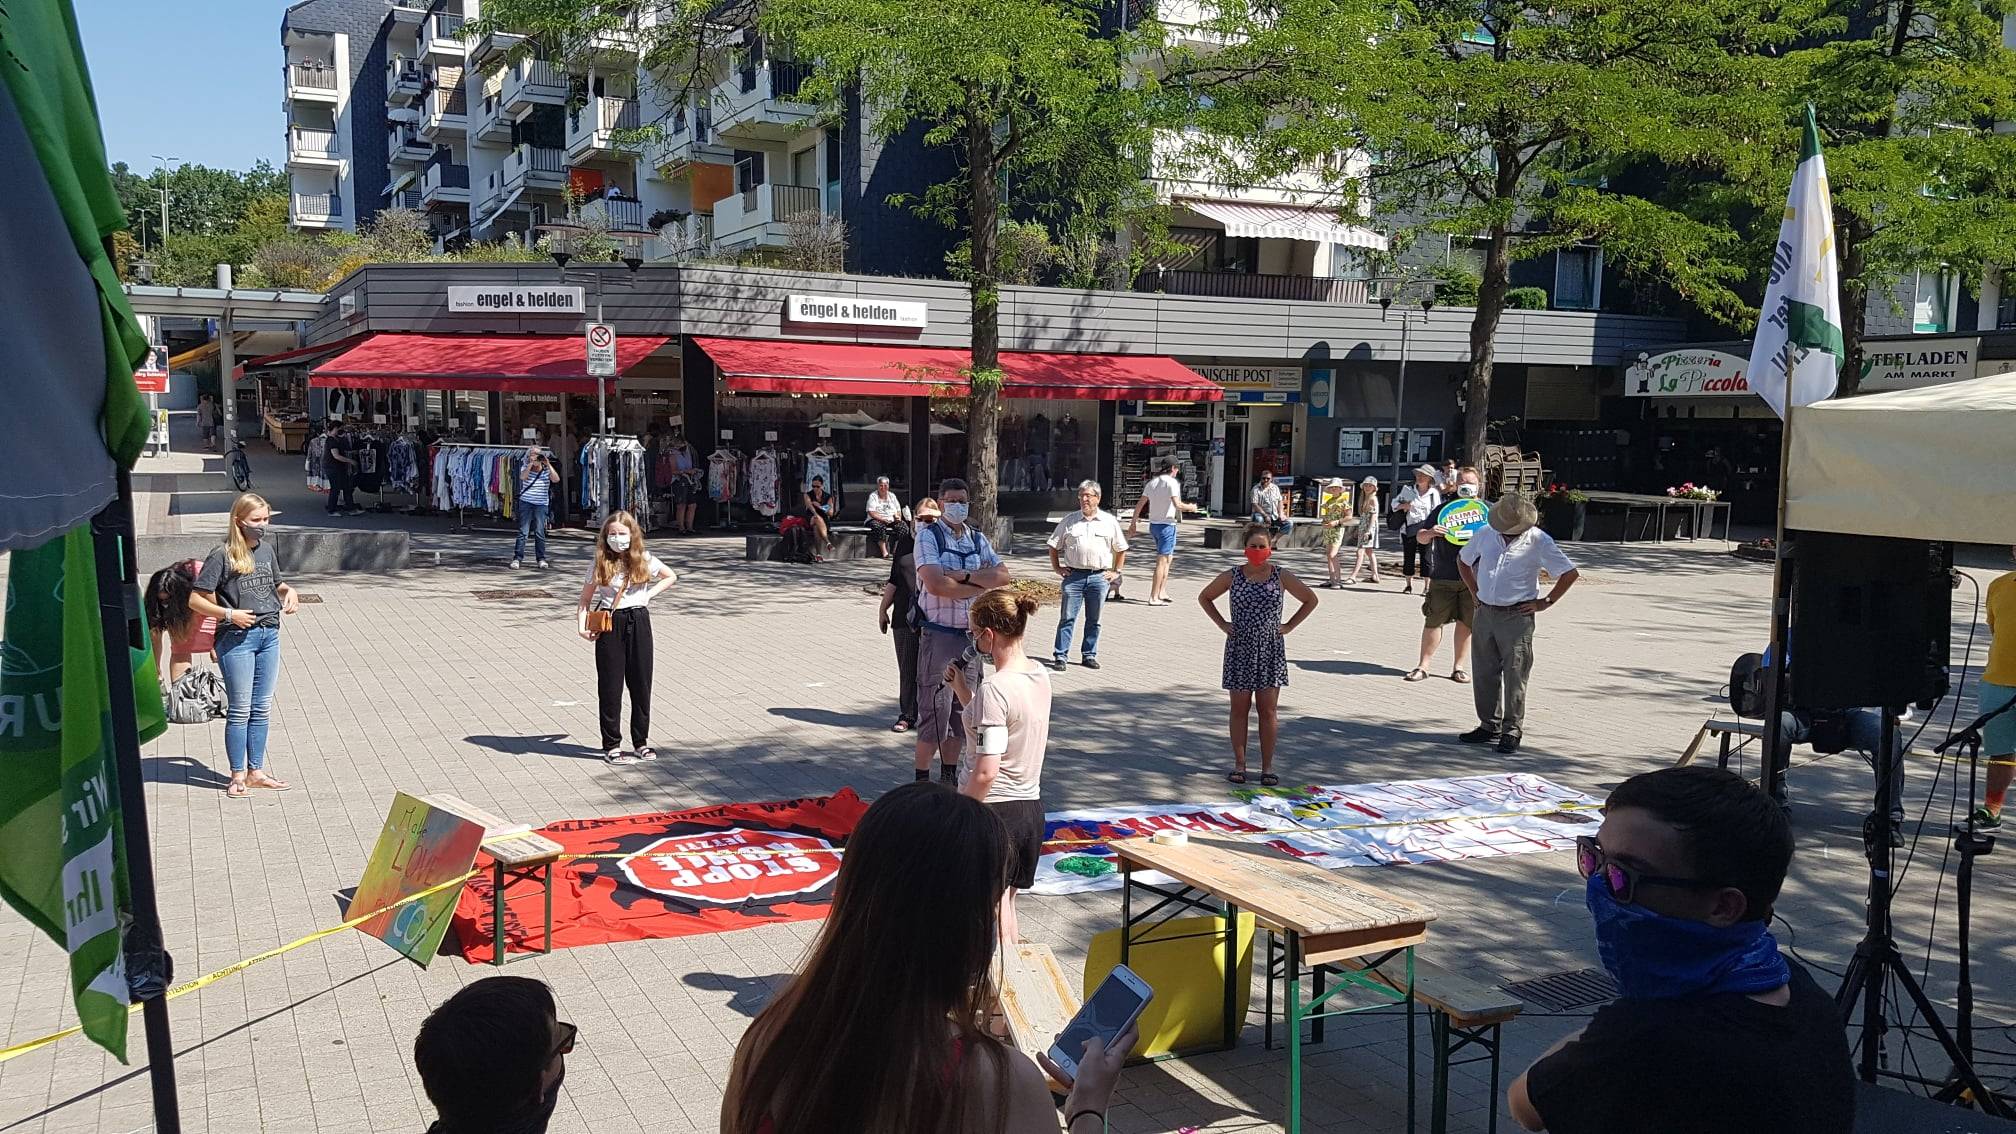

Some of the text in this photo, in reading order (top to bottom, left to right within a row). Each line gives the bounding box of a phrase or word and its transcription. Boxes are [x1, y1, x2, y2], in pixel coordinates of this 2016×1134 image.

[477, 292, 512, 308] engel
[516, 294, 525, 307] &
[528, 292, 573, 307] helden
[800, 303, 838, 318] engel
[841, 306, 850, 318] &
[853, 304, 897, 321] helden
[1661, 354, 1721, 370] Pizzeria
[1872, 350, 1968, 366] TEELADEN
[1243, 369, 1272, 382] POST
[1658, 369, 1748, 392] La Piccola
[1910, 370, 1957, 378] MARKT
[1448, 510, 1478, 521] KLIMA
[675, 834, 747, 852] JETZT!
[651, 842, 802, 871] KOHLE
[671, 857, 821, 887] STOPP
[167, 964, 242, 995] TTENTION ACHTUNG
